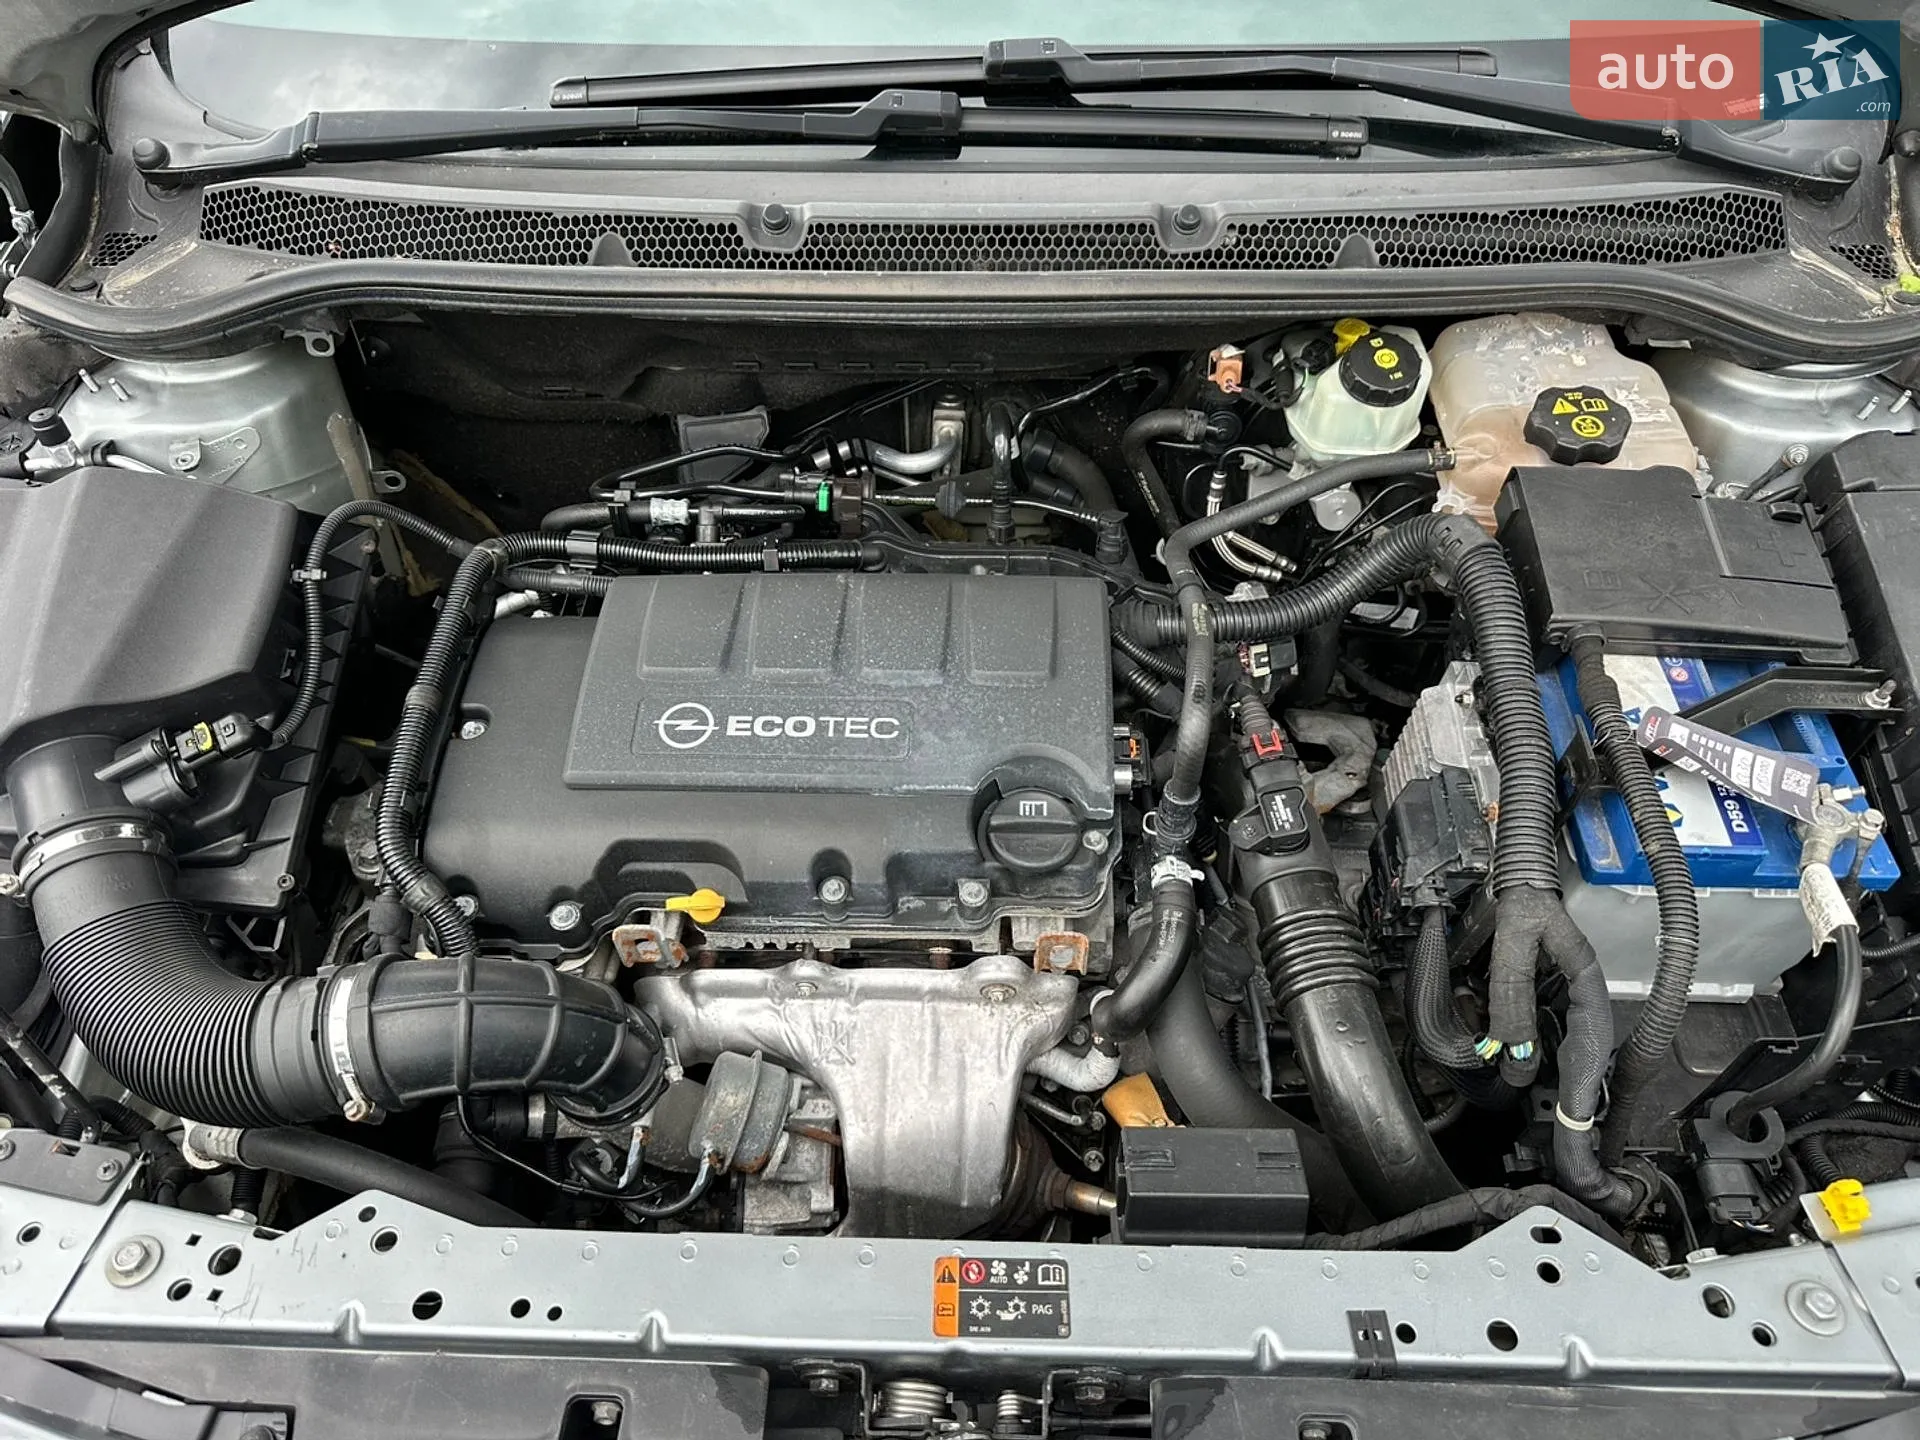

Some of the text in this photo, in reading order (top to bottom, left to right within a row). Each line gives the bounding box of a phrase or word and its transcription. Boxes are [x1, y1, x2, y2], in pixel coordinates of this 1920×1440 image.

[726, 715, 900, 739] ECOTEC
[1724, 800, 1750, 833] D59
[990, 1276, 1008, 1284] AUTO
[1031, 1304, 1054, 1315] PAG
